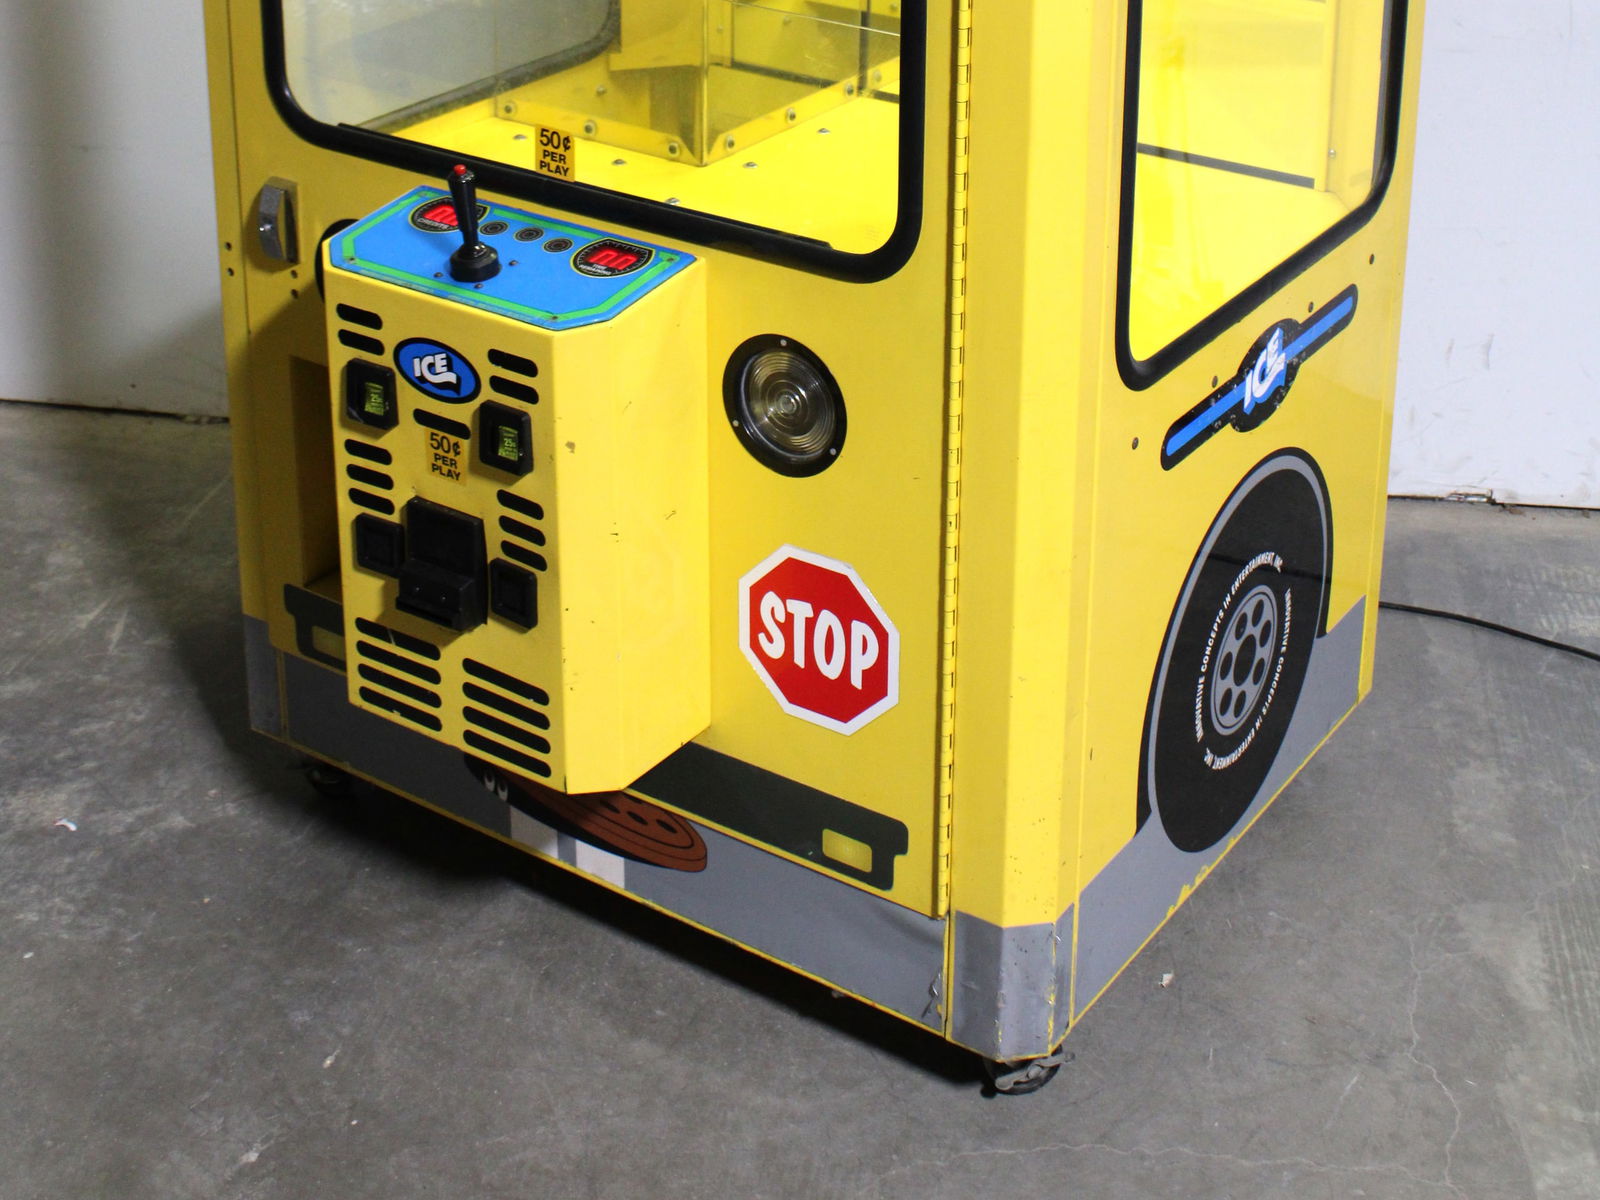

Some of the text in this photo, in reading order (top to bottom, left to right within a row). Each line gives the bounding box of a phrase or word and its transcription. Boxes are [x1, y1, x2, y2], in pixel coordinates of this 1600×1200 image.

[539, 127, 571, 152] 50¢
[539, 160, 569, 177] PLAY
[543, 149, 567, 165] PER
[413, 353, 457, 385] ICE
[1244, 327, 1287, 409] ICE
[430, 431, 461, 457] 50¢
[431, 462, 461, 481] PLAY
[434, 452, 458, 470] PER
[757, 590, 880, 691] STOP
[1200, 608, 1225, 673] CONCEPTS
[1223, 592, 1232, 610] IN
[1261, 656, 1285, 716] CONCEPTS
[1254, 714, 1263, 731] IN
